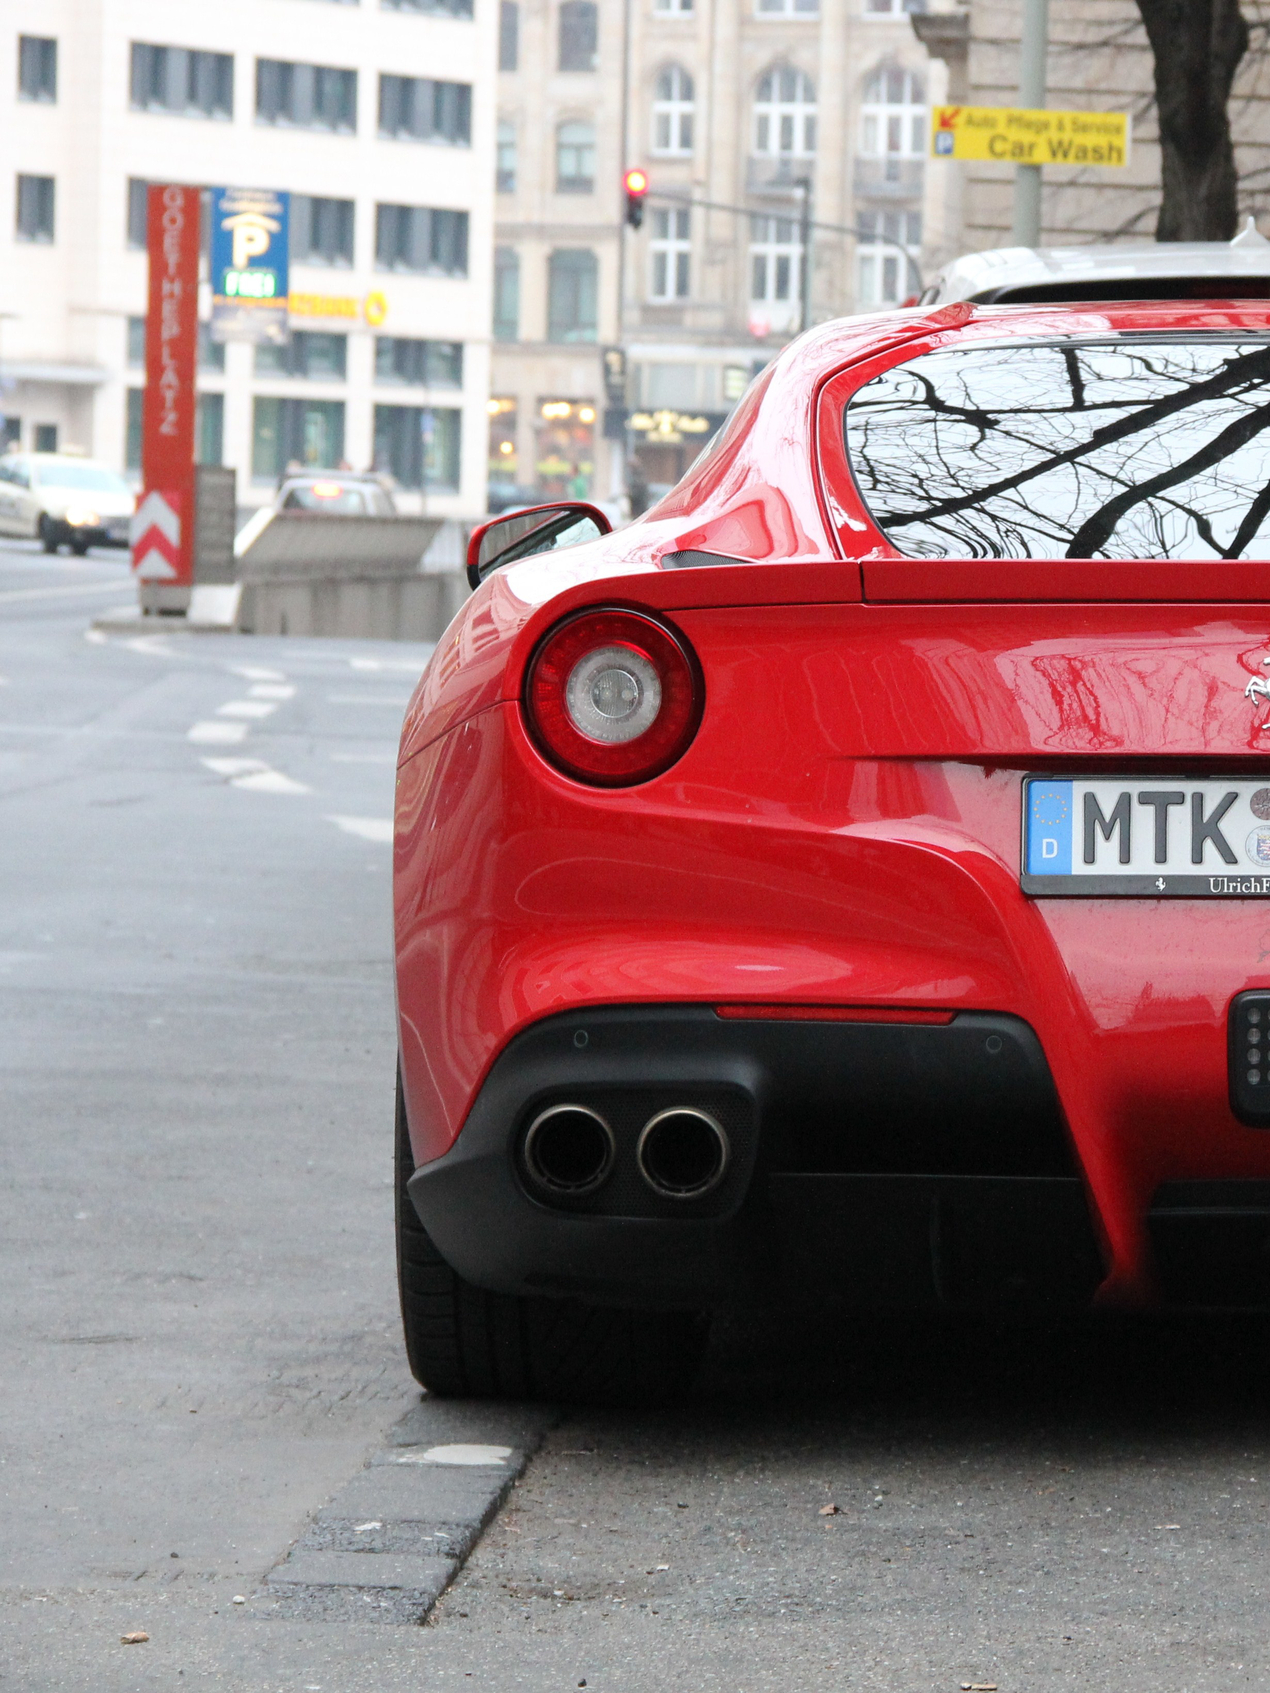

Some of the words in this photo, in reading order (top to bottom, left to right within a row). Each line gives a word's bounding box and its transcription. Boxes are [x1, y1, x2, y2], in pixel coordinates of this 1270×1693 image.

[965, 108, 998, 129] Auto
[1071, 117, 1122, 135] Service
[988, 134, 1036, 158] Car
[1049, 138, 1123, 163] Wash
[159, 184, 184, 436] GOETHEPLATZ
[1083, 791, 1239, 865] MTK
[1042, 837, 1058, 859] D
